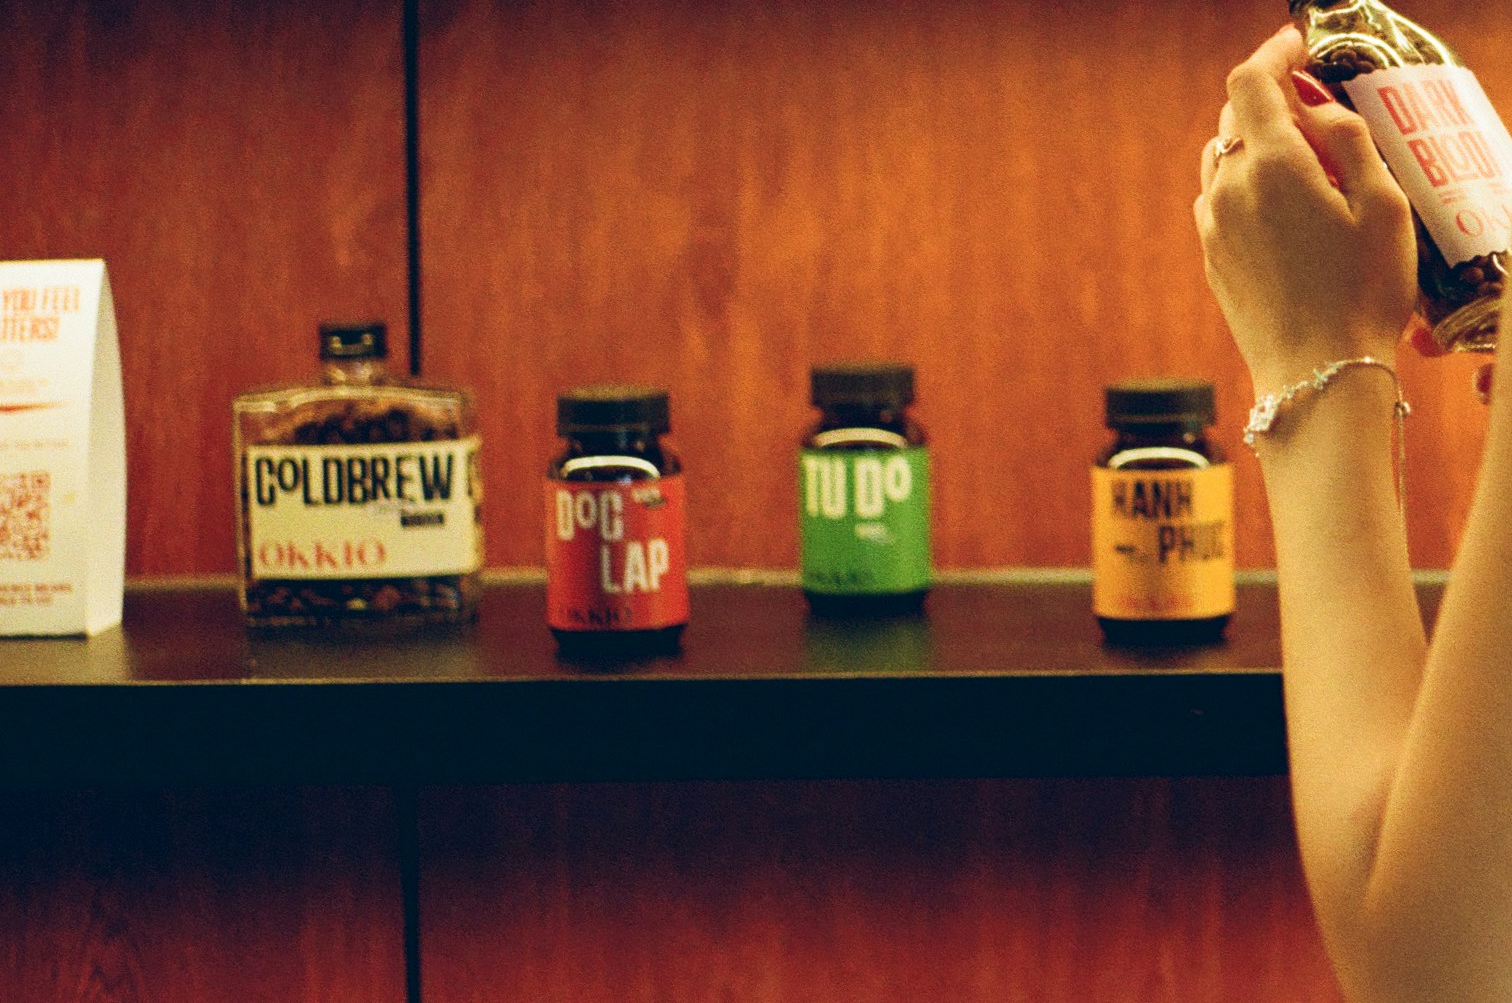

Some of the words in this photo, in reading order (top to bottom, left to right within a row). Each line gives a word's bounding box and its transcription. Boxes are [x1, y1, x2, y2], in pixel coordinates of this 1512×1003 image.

[1377, 79, 1476, 135] DARK
[257, 538, 387, 571] OKKIO
[602, 538, 669, 594] LAP
